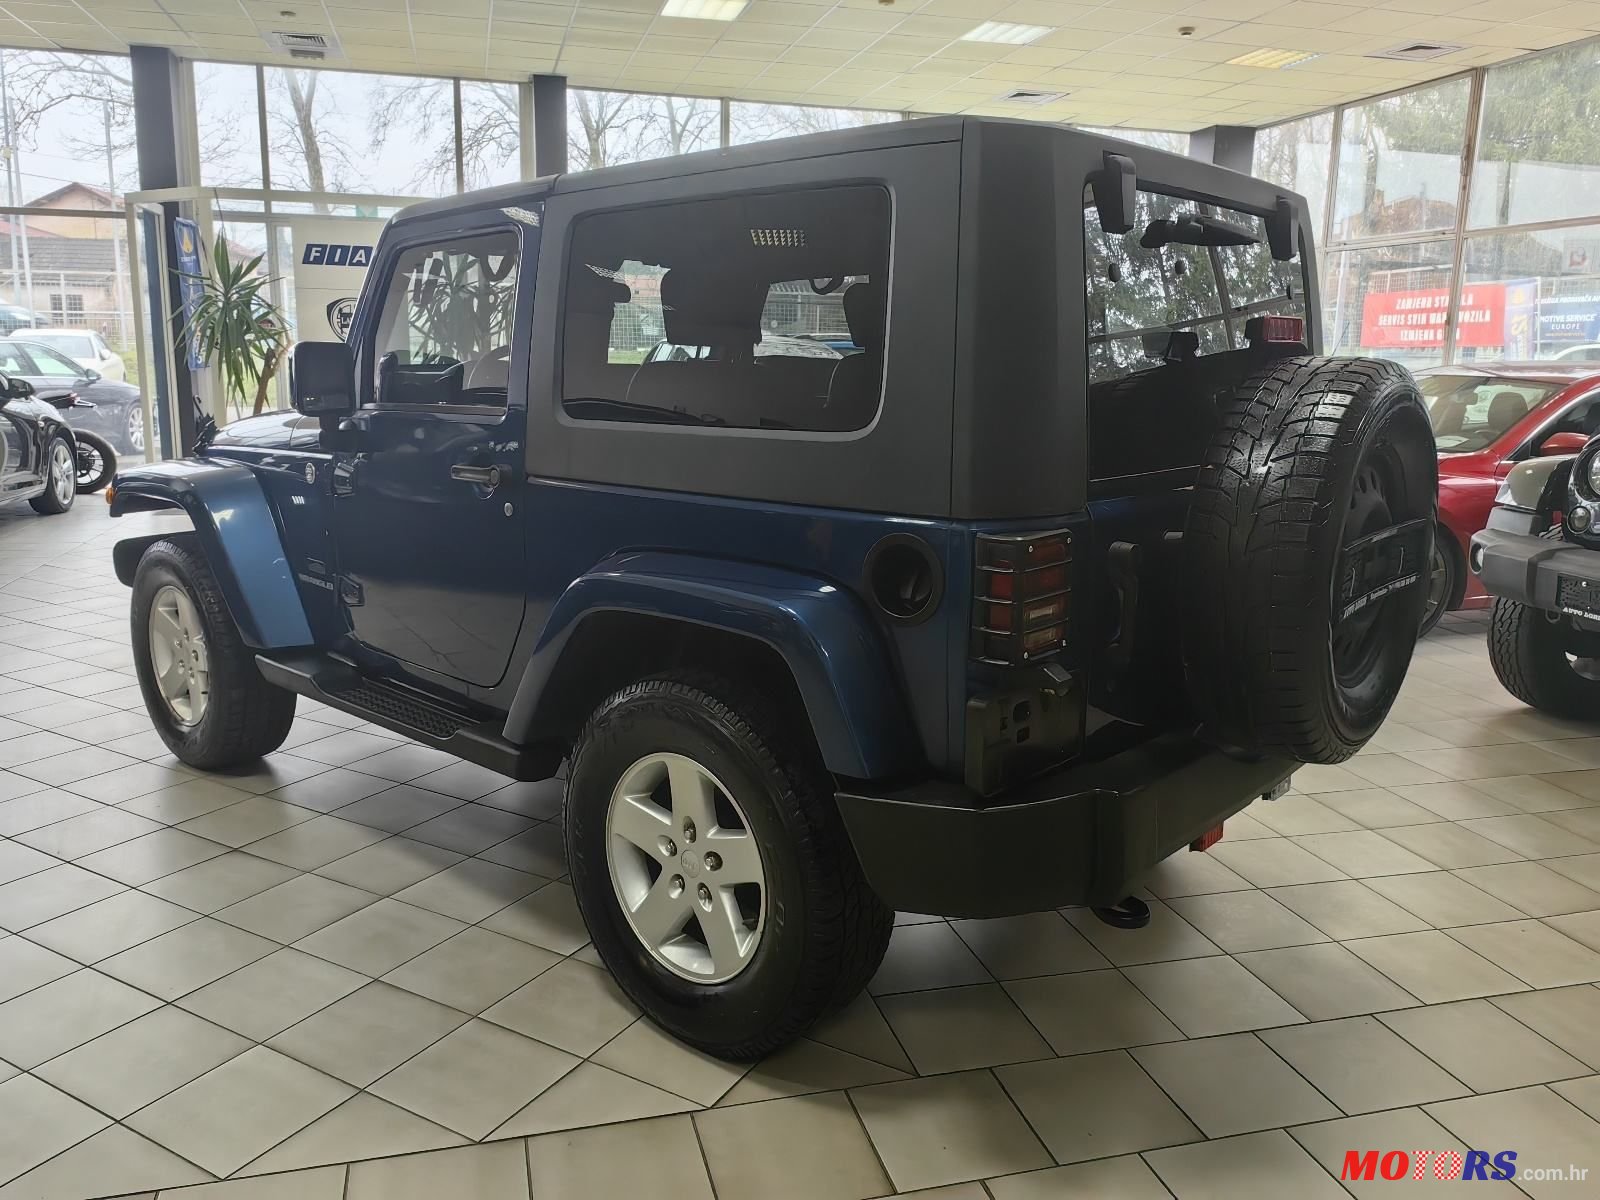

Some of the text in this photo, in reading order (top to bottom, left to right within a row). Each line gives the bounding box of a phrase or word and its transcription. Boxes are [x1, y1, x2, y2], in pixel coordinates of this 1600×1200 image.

[306, 246, 370, 265] FIA
[1395, 294, 1474, 310] ZAMJENA STALA
[1378, 314, 1405, 326] SERVIS
[1407, 313, 1427, 325] SVIH
[1459, 310, 1491, 323] VOZILA
[1540, 313, 1597, 323] MOTIVE SERVICE
[1400, 329, 1434, 341] IZMJENA
[1562, 606, 1583, 617] AUTO
